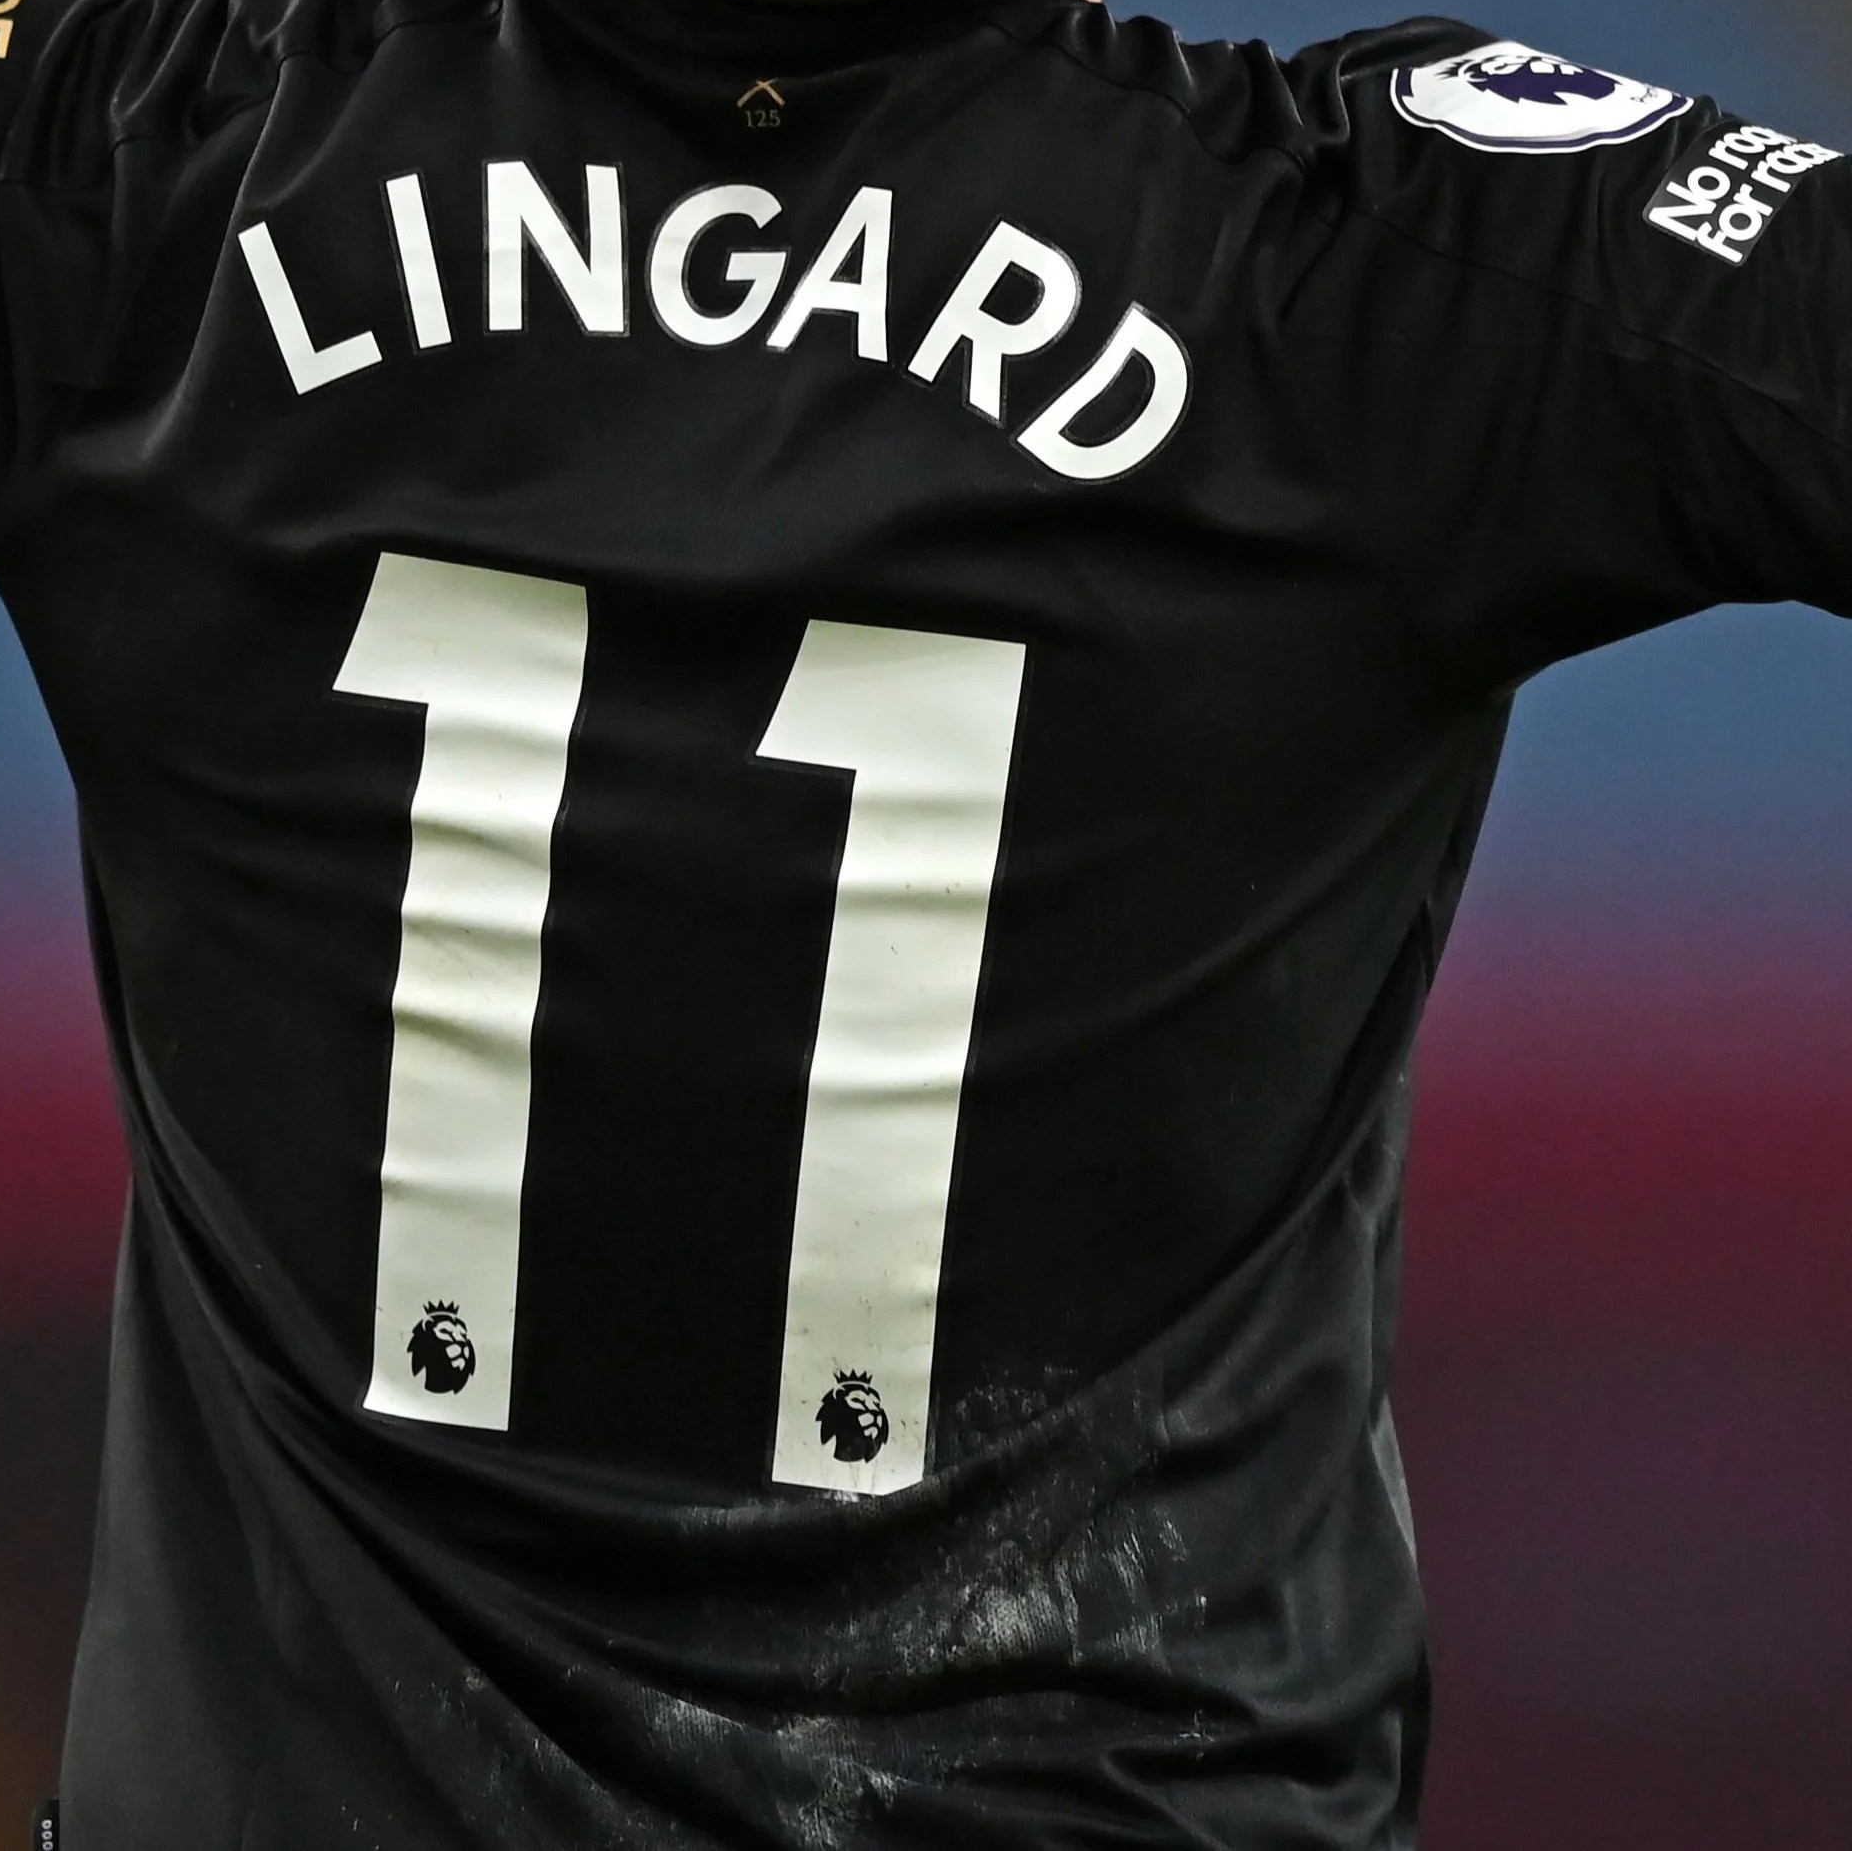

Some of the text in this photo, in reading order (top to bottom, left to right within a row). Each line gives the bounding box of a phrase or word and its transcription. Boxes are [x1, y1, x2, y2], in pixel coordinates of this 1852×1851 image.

[238, 160, 1190, 480] LINGARD
[1648, 166, 1731, 242] No
[332, 552, 1027, 1496] 11
